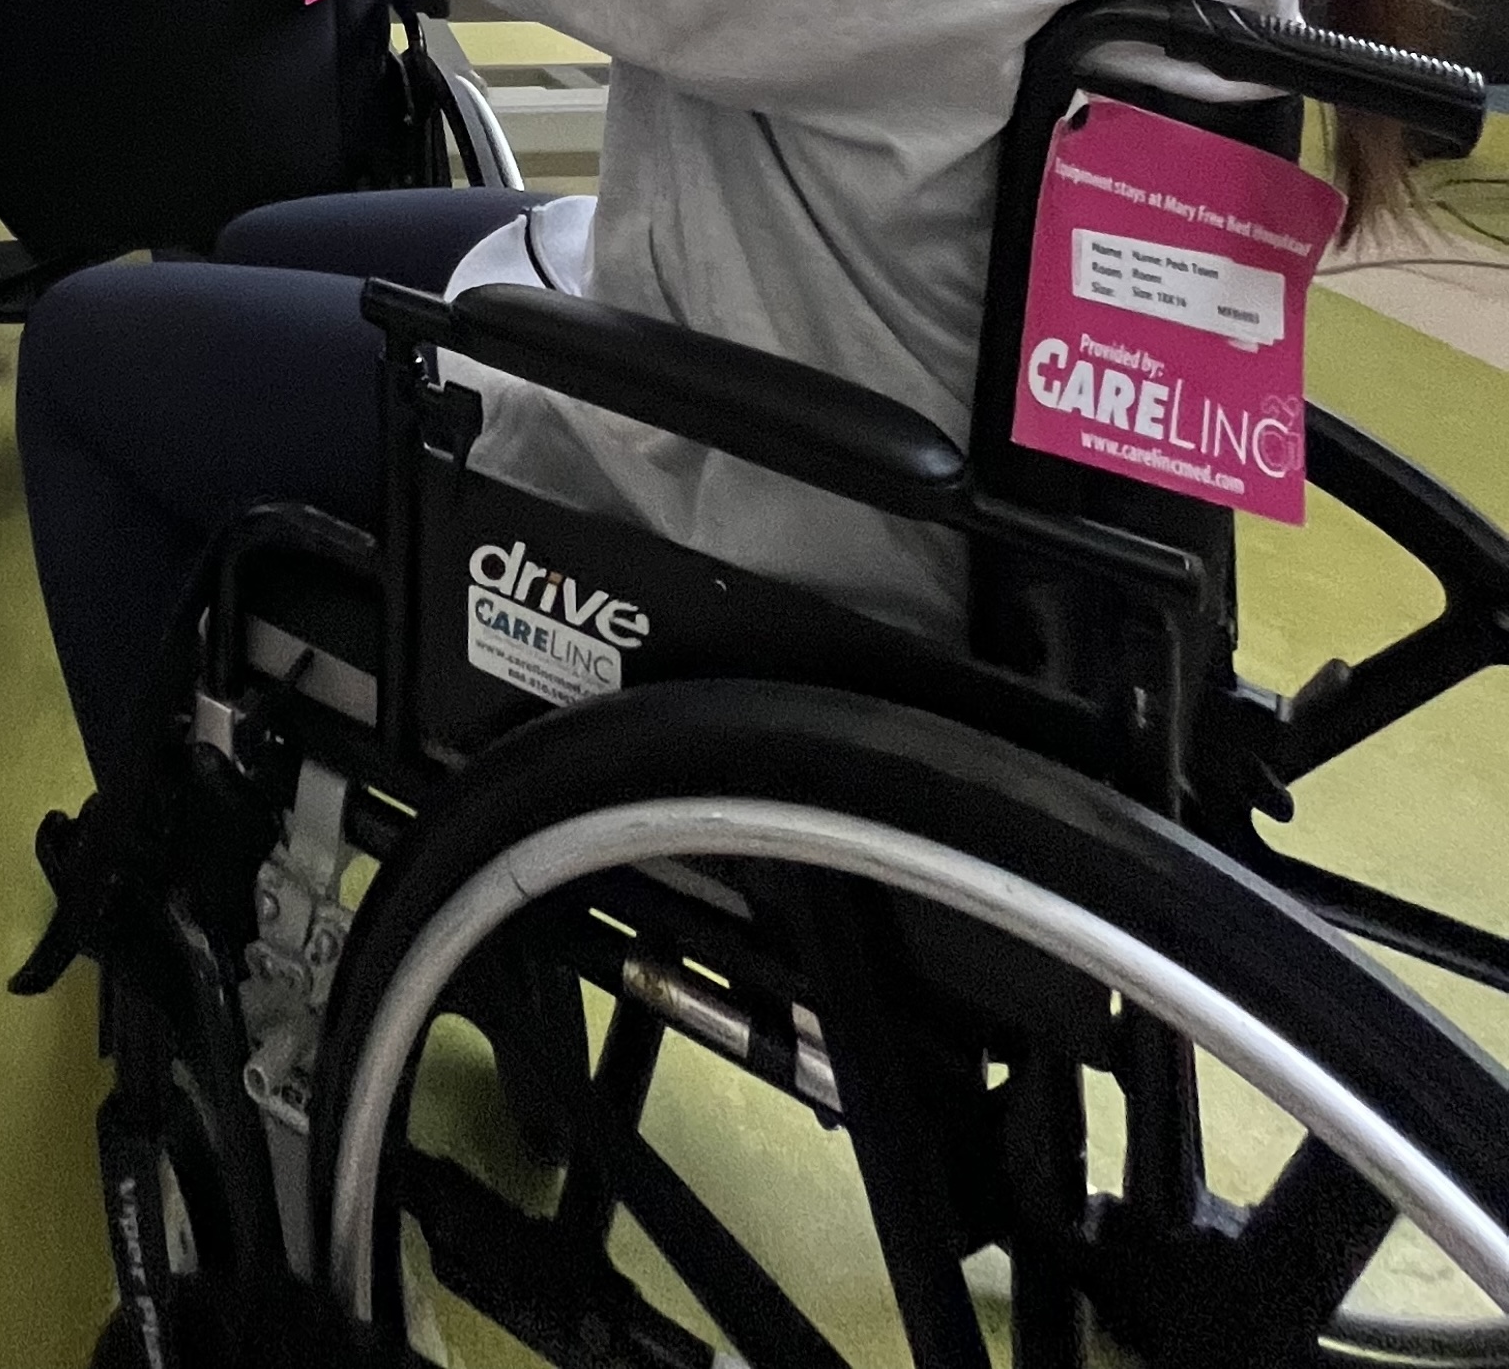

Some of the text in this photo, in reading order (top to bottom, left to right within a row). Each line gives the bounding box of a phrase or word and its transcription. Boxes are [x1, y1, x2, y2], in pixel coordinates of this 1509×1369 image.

[1114, 181, 1147, 204] stays
[1148, 192, 1163, 208] at
[1164, 195, 1196, 223] Mary
[1198, 204, 1225, 229] Free
[1080, 333, 1164, 378] Provided by:
[1028, 338, 1285, 478] CARELINC
[1081, 431, 1244, 494] www.carelincmed.com
[469, 541, 649, 648] drive
[475, 598, 613, 684] CARELINC
